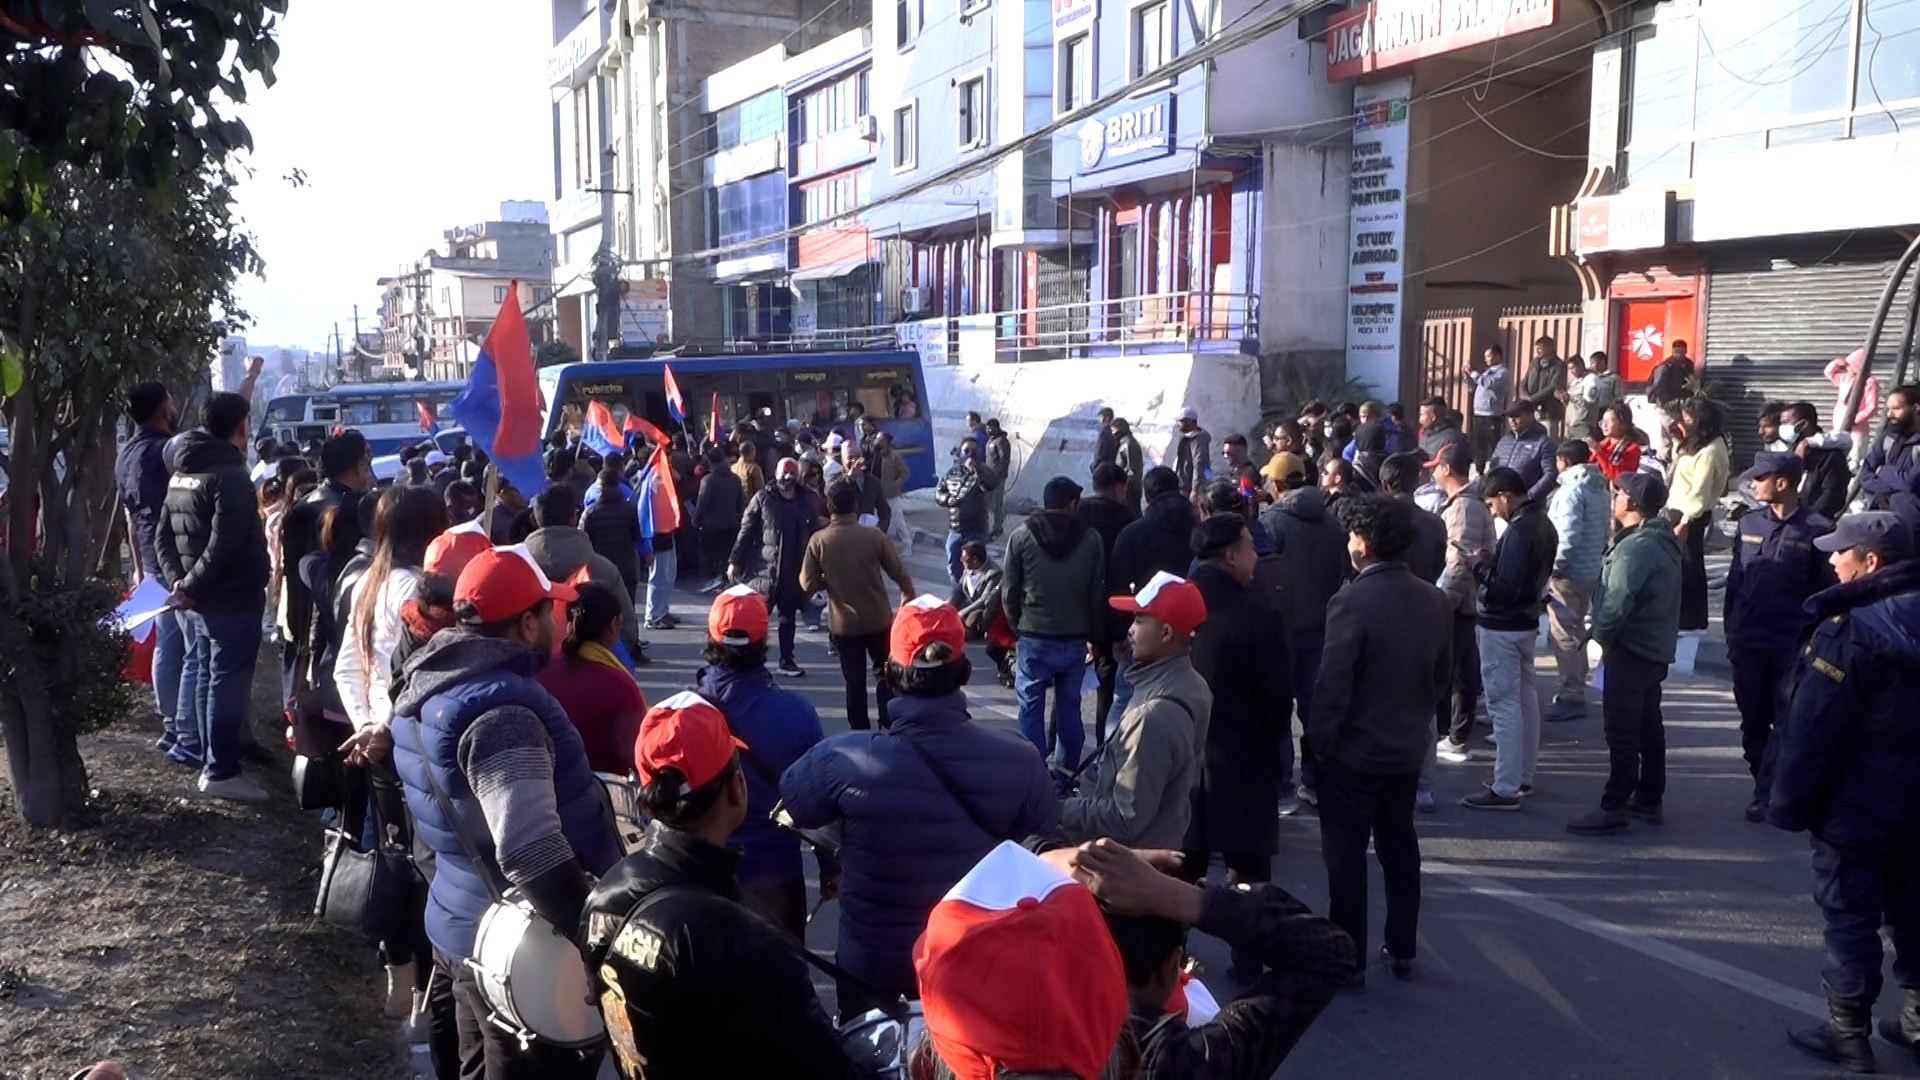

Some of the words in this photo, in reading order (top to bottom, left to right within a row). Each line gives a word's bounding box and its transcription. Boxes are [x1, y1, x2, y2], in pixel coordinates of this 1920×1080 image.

[1328, 0, 1441, 65] JAGANNATH
[1107, 103, 1164, 144] BRITI
[1354, 141, 1382, 158] YOUR
[1351, 174, 1388, 191] STUDY
[1351, 189, 1401, 207] PARTNER
[1612, 210, 1656, 231] ATM
[1357, 231, 1395, 247] STUDY
[1352, 248, 1399, 265] ABROAD
